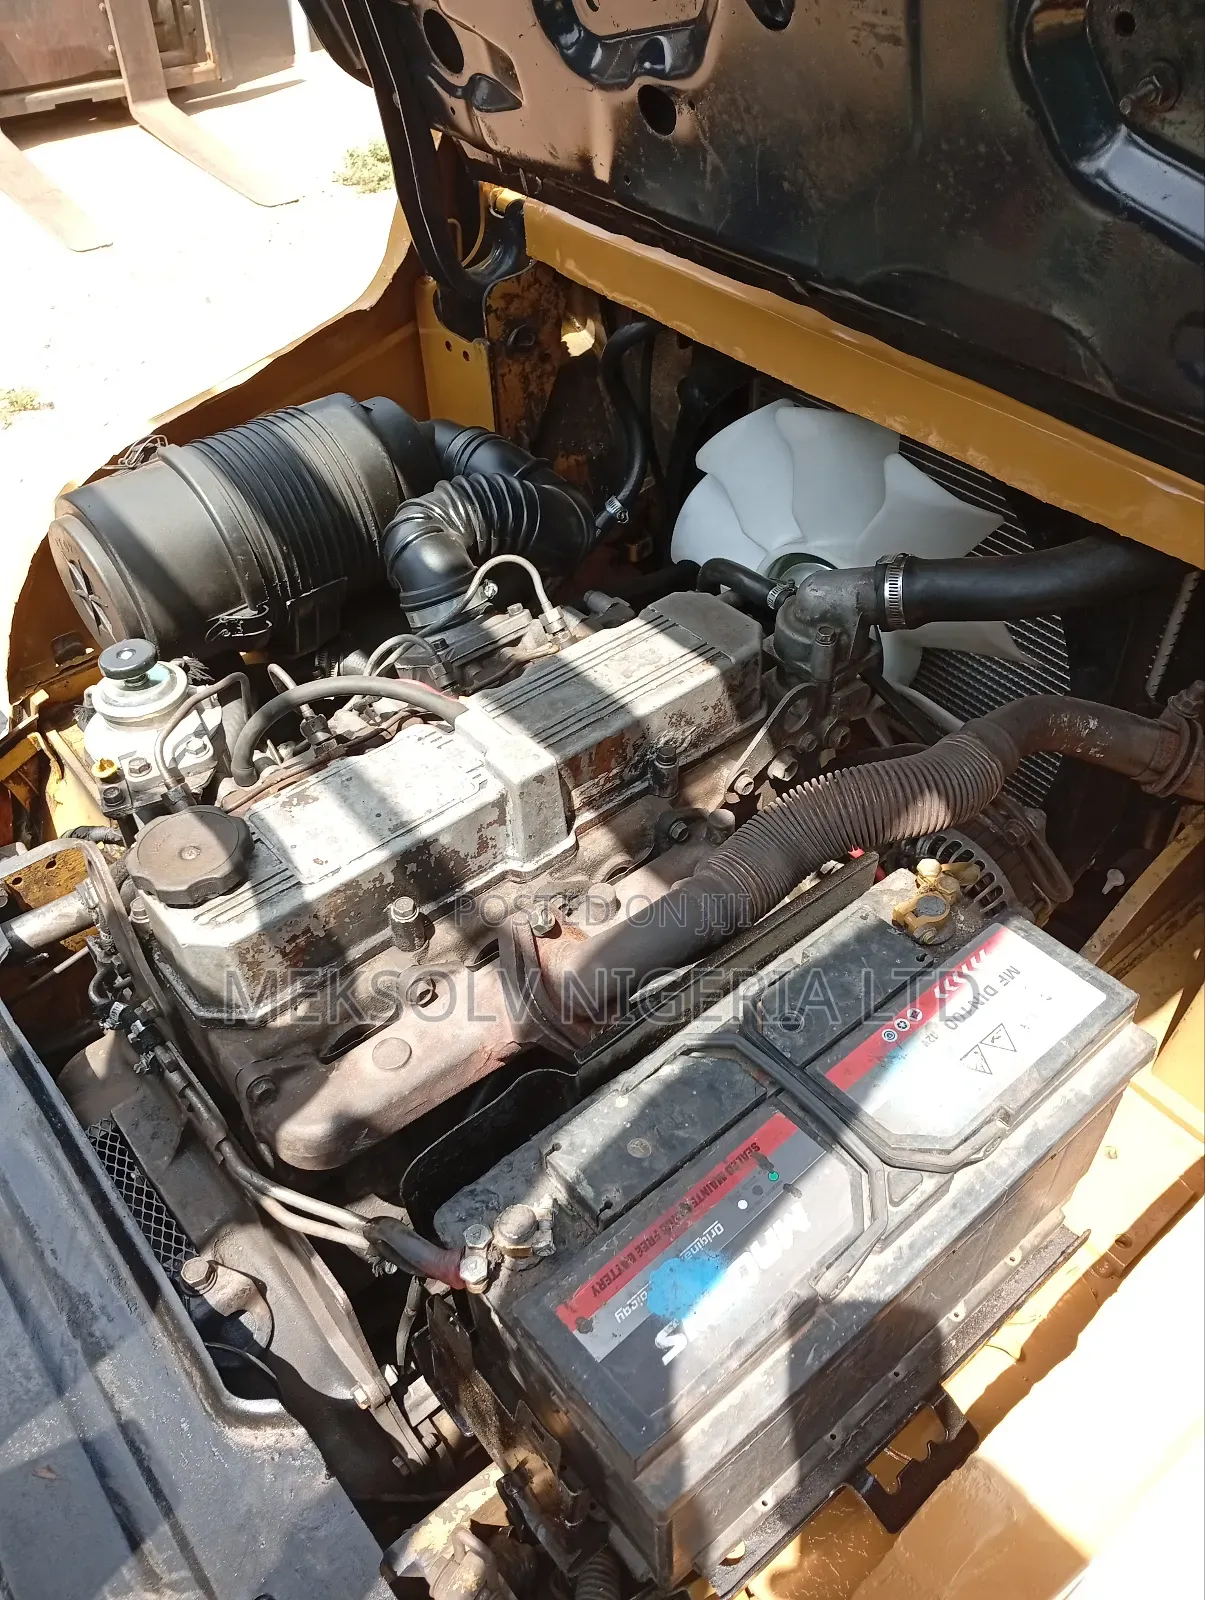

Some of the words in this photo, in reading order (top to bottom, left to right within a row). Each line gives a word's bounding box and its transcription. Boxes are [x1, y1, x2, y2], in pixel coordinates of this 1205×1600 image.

[998, 965, 1020, 986] MF
[634, 1229, 661, 1258] FREE
[680, 1221, 725, 1260] Origina
[591, 1251, 637, 1298] BATTERY
